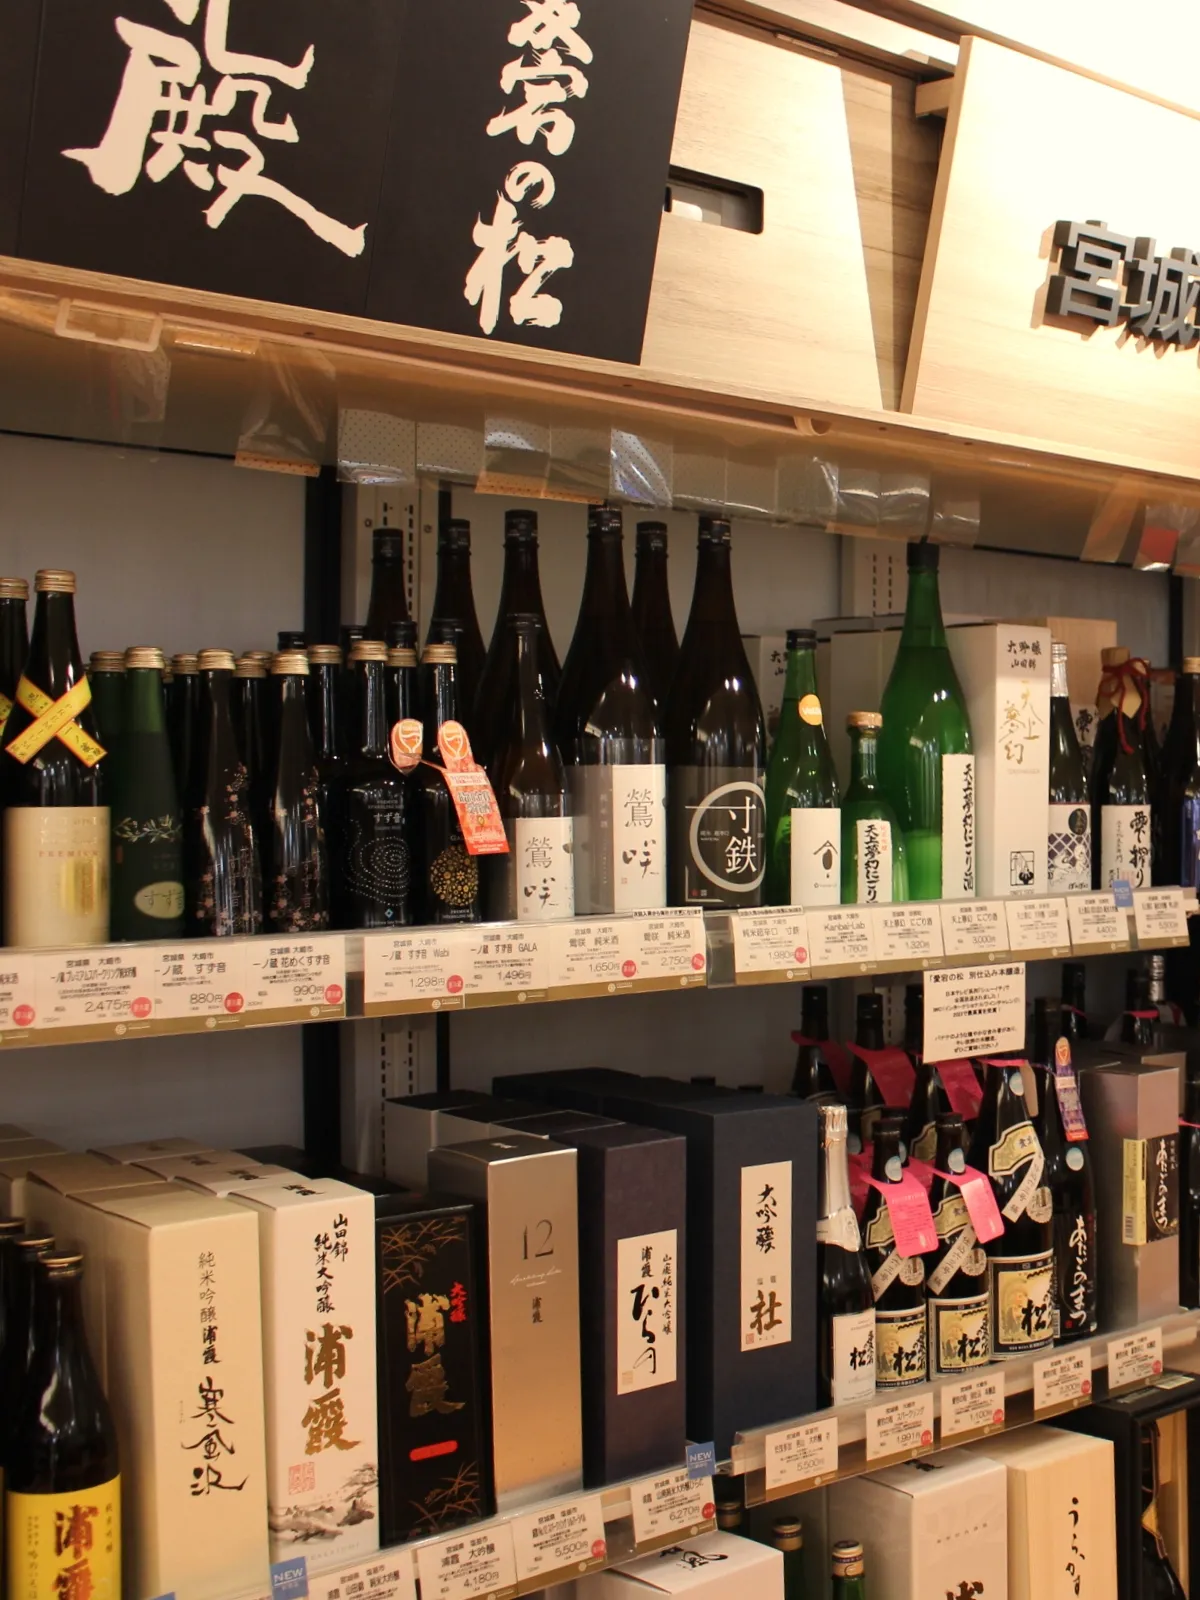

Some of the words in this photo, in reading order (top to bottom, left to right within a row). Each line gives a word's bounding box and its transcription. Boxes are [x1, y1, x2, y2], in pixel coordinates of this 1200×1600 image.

[622, 789, 659, 879] 鶯咲
[722, 796, 757, 874] 寸鉄
[864, 824, 880, 903] 天上夢幻にごり
[524, 836, 559, 908] 鶯咲
[190, 992, 223, 1005] 880円
[293, 984, 324, 996] 990円
[315, 1232, 336, 1314] 純米大吟醸
[332, 1213, 349, 1262] 山田錦
[522, 1219, 555, 1261] 12
[199, 1251, 217, 1323] 純米吟醸
[202, 1326, 221, 1365] 浦霞
[404, 1292, 466, 1418] 浦霞
[301, 1322, 362, 1456] 浦霞
[690, 1451, 712, 1462] NEW
[273, 1567, 304, 1582] NEW
